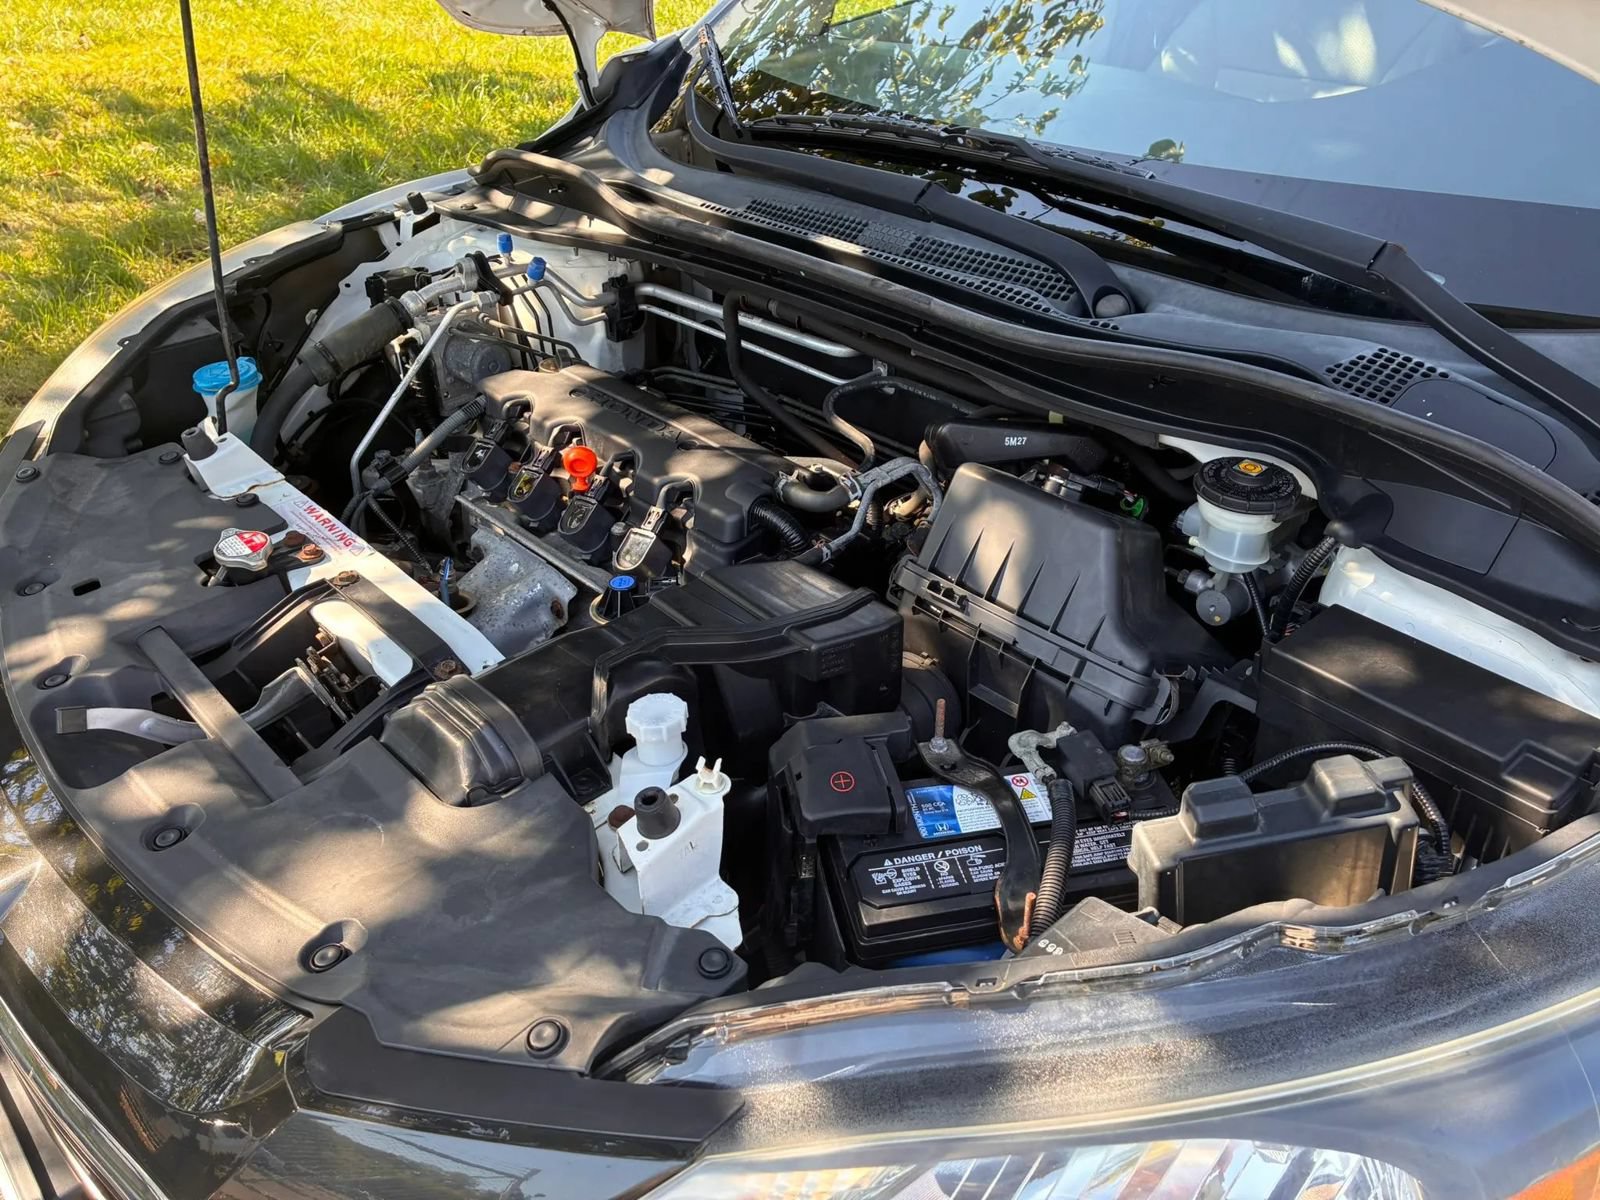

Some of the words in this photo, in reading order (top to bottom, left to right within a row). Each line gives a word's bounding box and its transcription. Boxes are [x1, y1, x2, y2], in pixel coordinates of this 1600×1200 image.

[1004, 436, 1028, 447] 5M27
[303, 504, 357, 547] WARNING
[893, 852, 935, 865] DANGER
[945, 845, 982, 856] POISON
